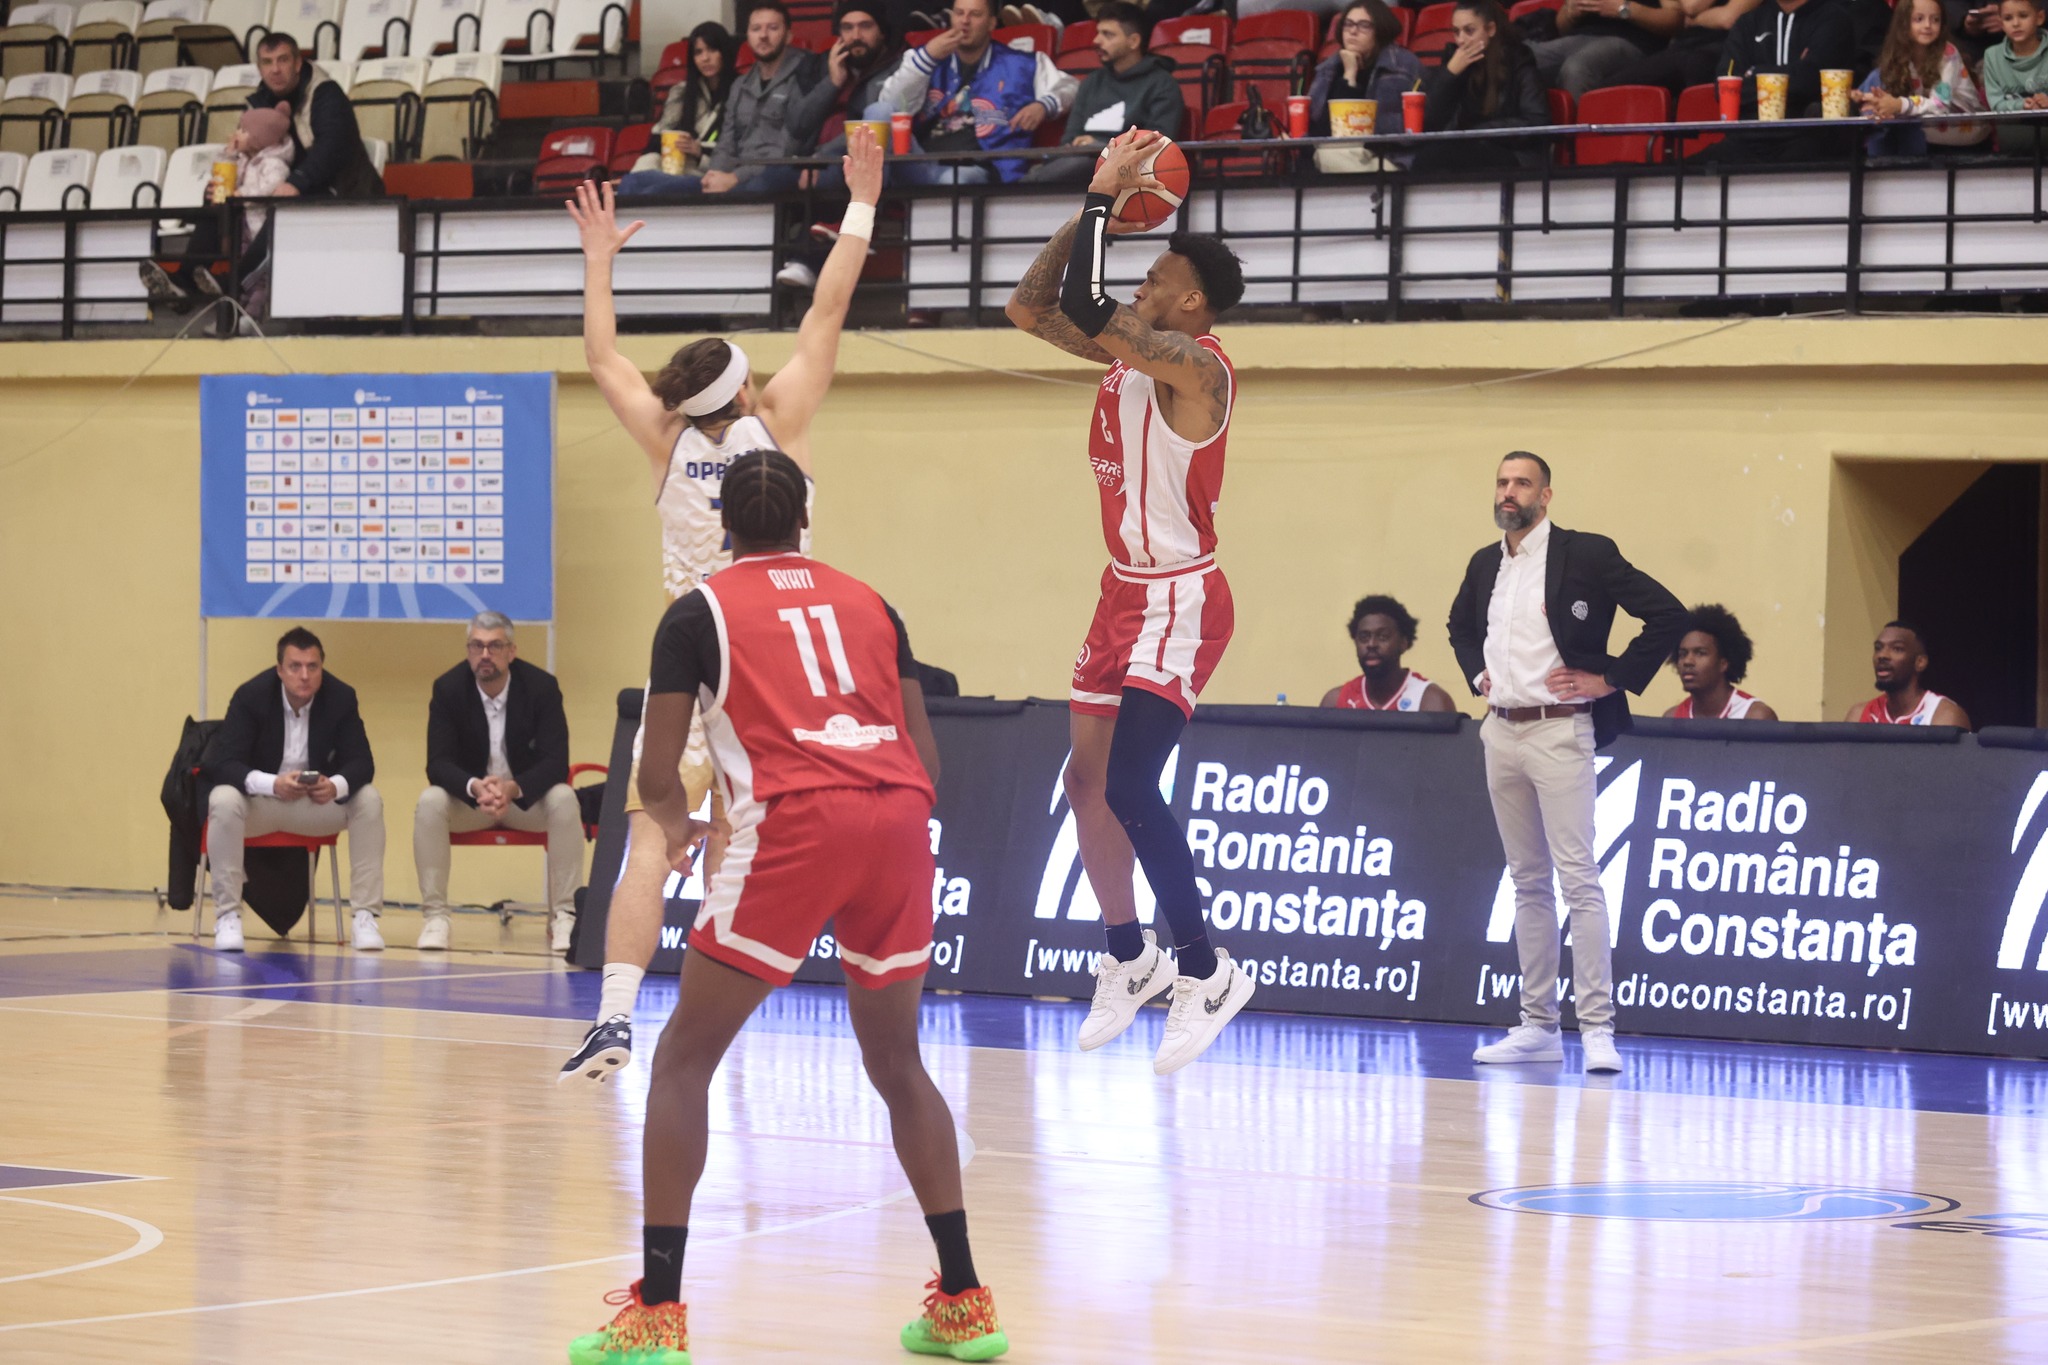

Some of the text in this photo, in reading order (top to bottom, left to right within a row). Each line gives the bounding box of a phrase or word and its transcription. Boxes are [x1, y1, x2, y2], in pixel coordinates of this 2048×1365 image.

[767, 568, 815, 590] AYAYI
[777, 604, 857, 697] 11
[1191, 761, 1329, 816] Radio
[1656, 777, 1808, 835] Radio
[1186, 818, 1394, 877] România
[1648, 837, 1880, 899] România
[1641, 898, 1918, 977] Constanța
